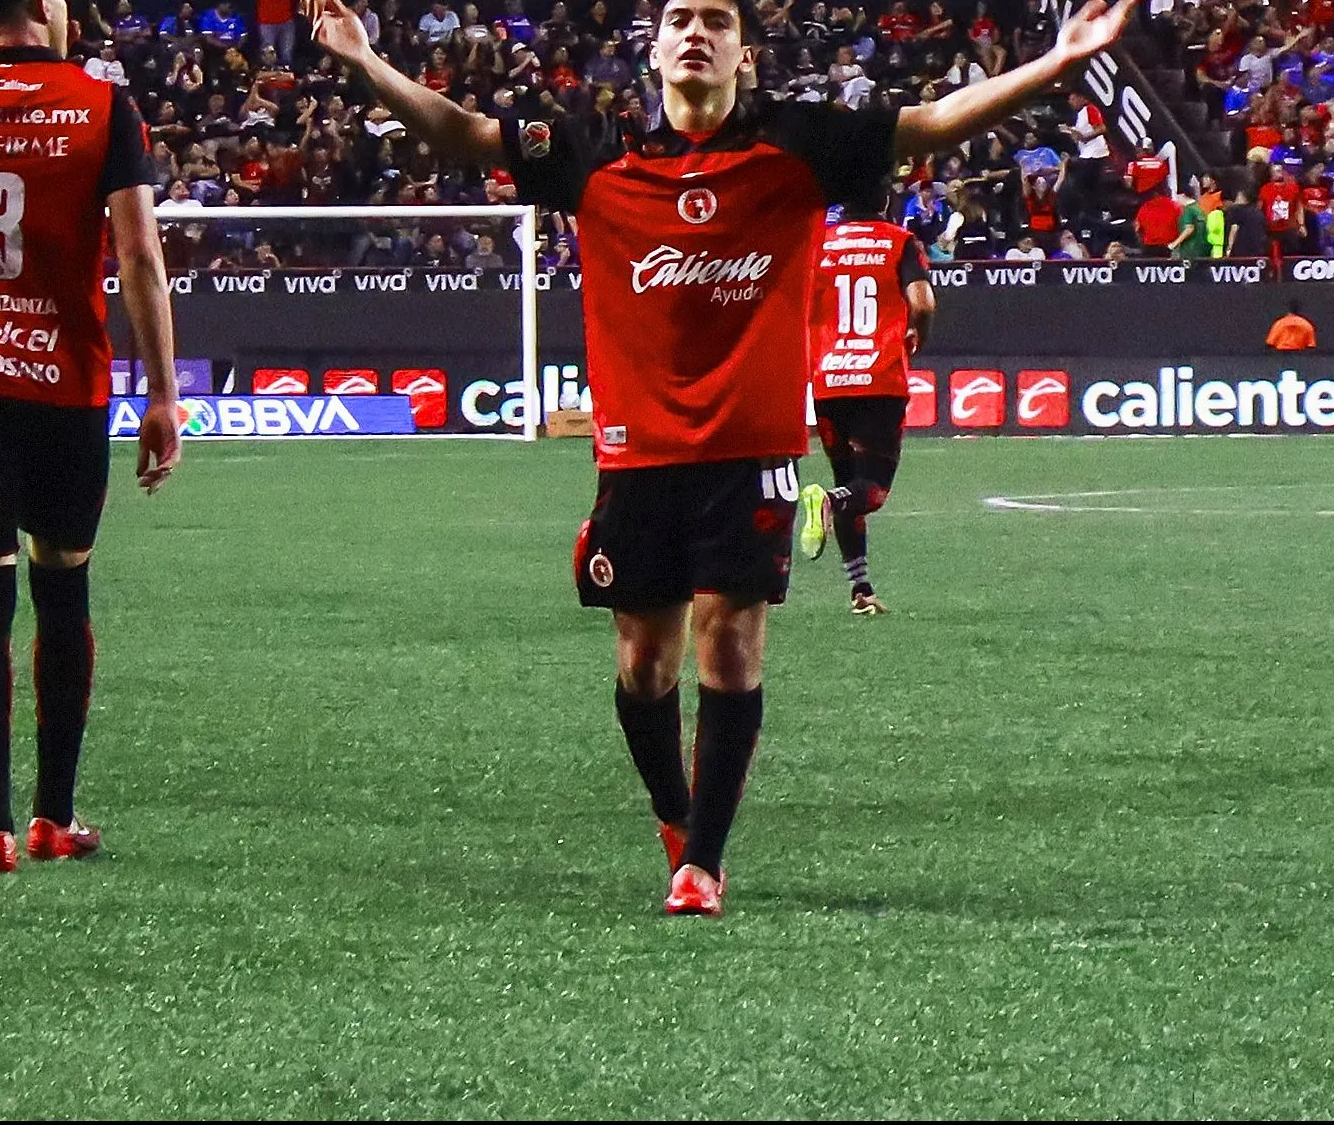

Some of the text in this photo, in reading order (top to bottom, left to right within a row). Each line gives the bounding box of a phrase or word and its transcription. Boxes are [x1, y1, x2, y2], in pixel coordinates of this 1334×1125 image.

[630, 245, 772, 294] Caliente
[834, 275, 877, 335] 16
[821, 351, 880, 371] telcel
[217, 397, 360, 435] BBVA
